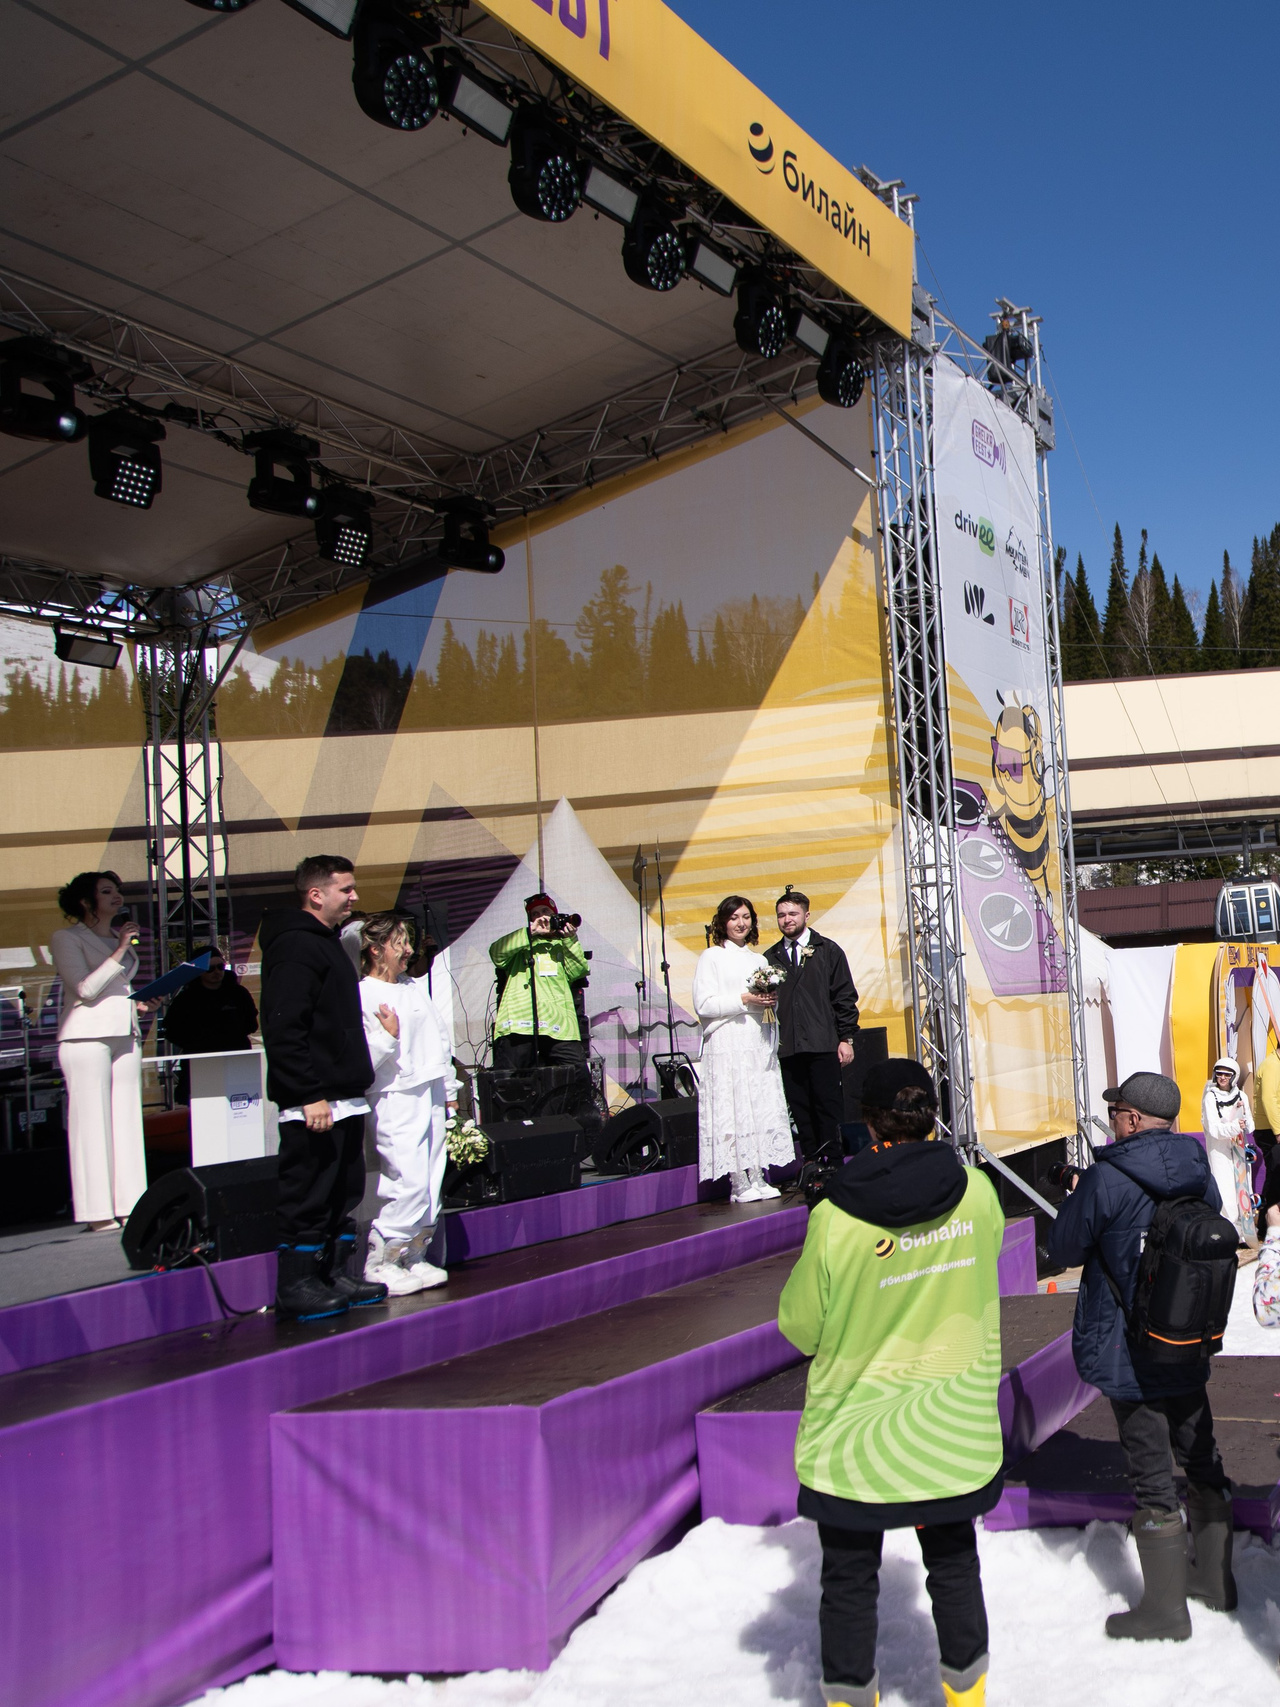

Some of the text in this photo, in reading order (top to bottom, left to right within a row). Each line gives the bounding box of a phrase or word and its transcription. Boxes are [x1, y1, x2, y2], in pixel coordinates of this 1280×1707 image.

[782, 149, 871, 258] билайн
[954, 509, 995, 551] drivee
[899, 1218, 974, 1252] билайн
[879, 1257, 977, 1289] #билайнсоединяет
